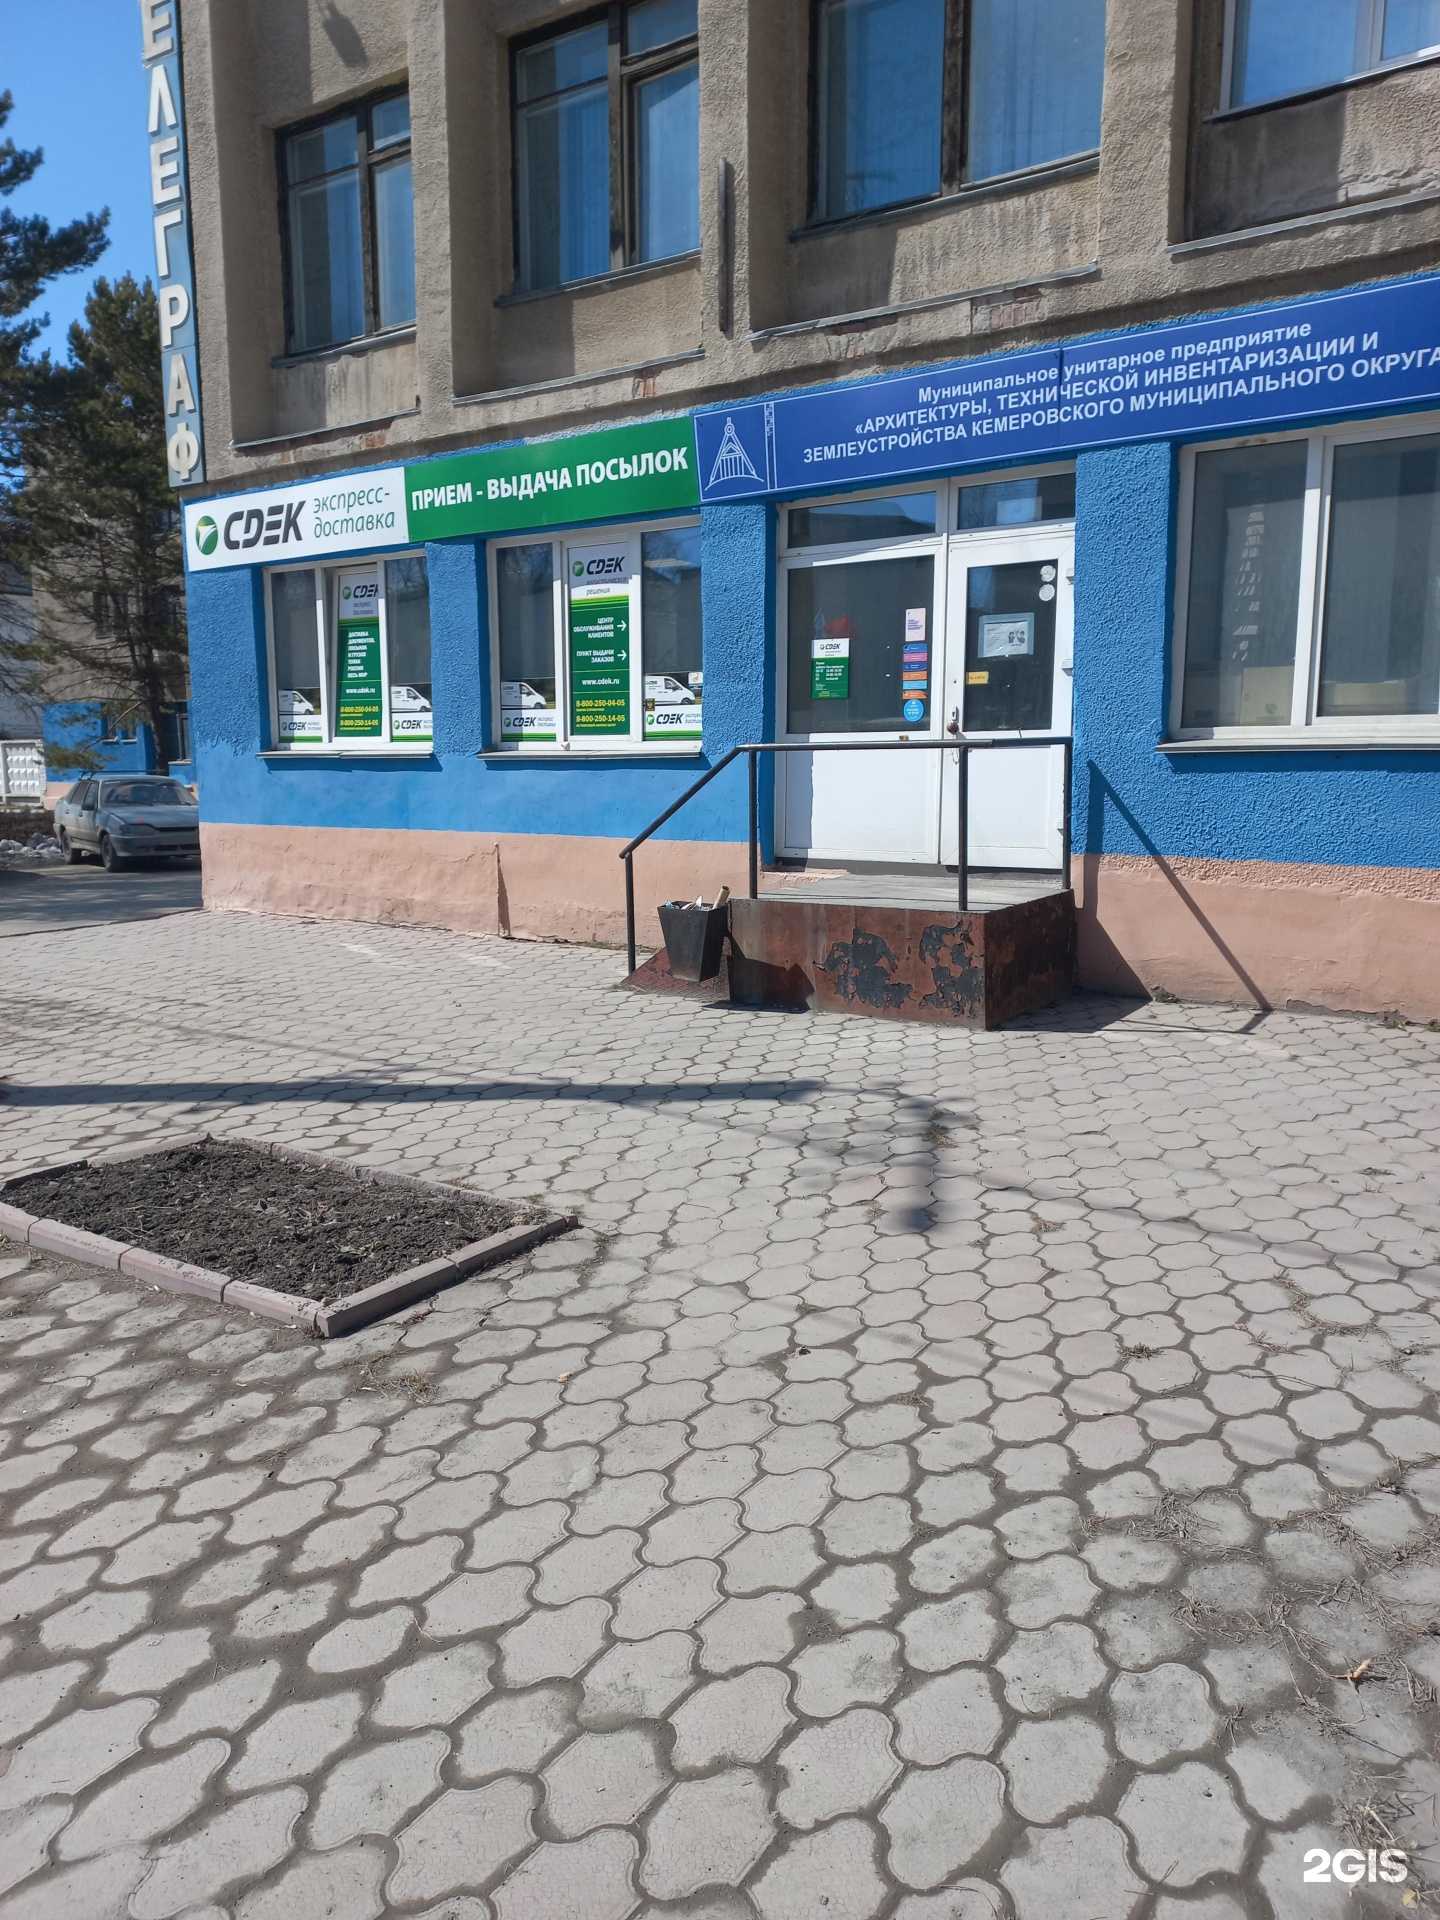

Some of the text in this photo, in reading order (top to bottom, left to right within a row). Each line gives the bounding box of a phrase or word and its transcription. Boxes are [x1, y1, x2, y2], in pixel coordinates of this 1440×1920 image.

[918, 323, 1312, 405] Муниципальное унитарное предприятие
[855, 331, 1379, 435] «АРХИТЕКТУРЫ, ТЕХНИЧЕСКОЙ ИНВЕНТАРИЗАЦИИ И
[803, 346, 1440, 464] ЗЕМЛЕУСТРОЙСТВА КЕМЕРОВСКОГО МУНИЦИПАЛЬНОГО ОКРУГА
[411, 482, 473, 511] ПРИЕМ
[487, 467, 573, 500] ВЫДАЧА
[576, 447, 689, 487] ПОСЫЛОК
[312, 486, 390, 514] экспресс-
[223, 500, 306, 550] CDEK
[313, 511, 395, 538] доставка
[586, 556, 625, 575] CDEK
[401, 719, 422, 729] CDEK
[512, 716, 537, 727] CDEK
[656, 712, 684, 725] CDEK
